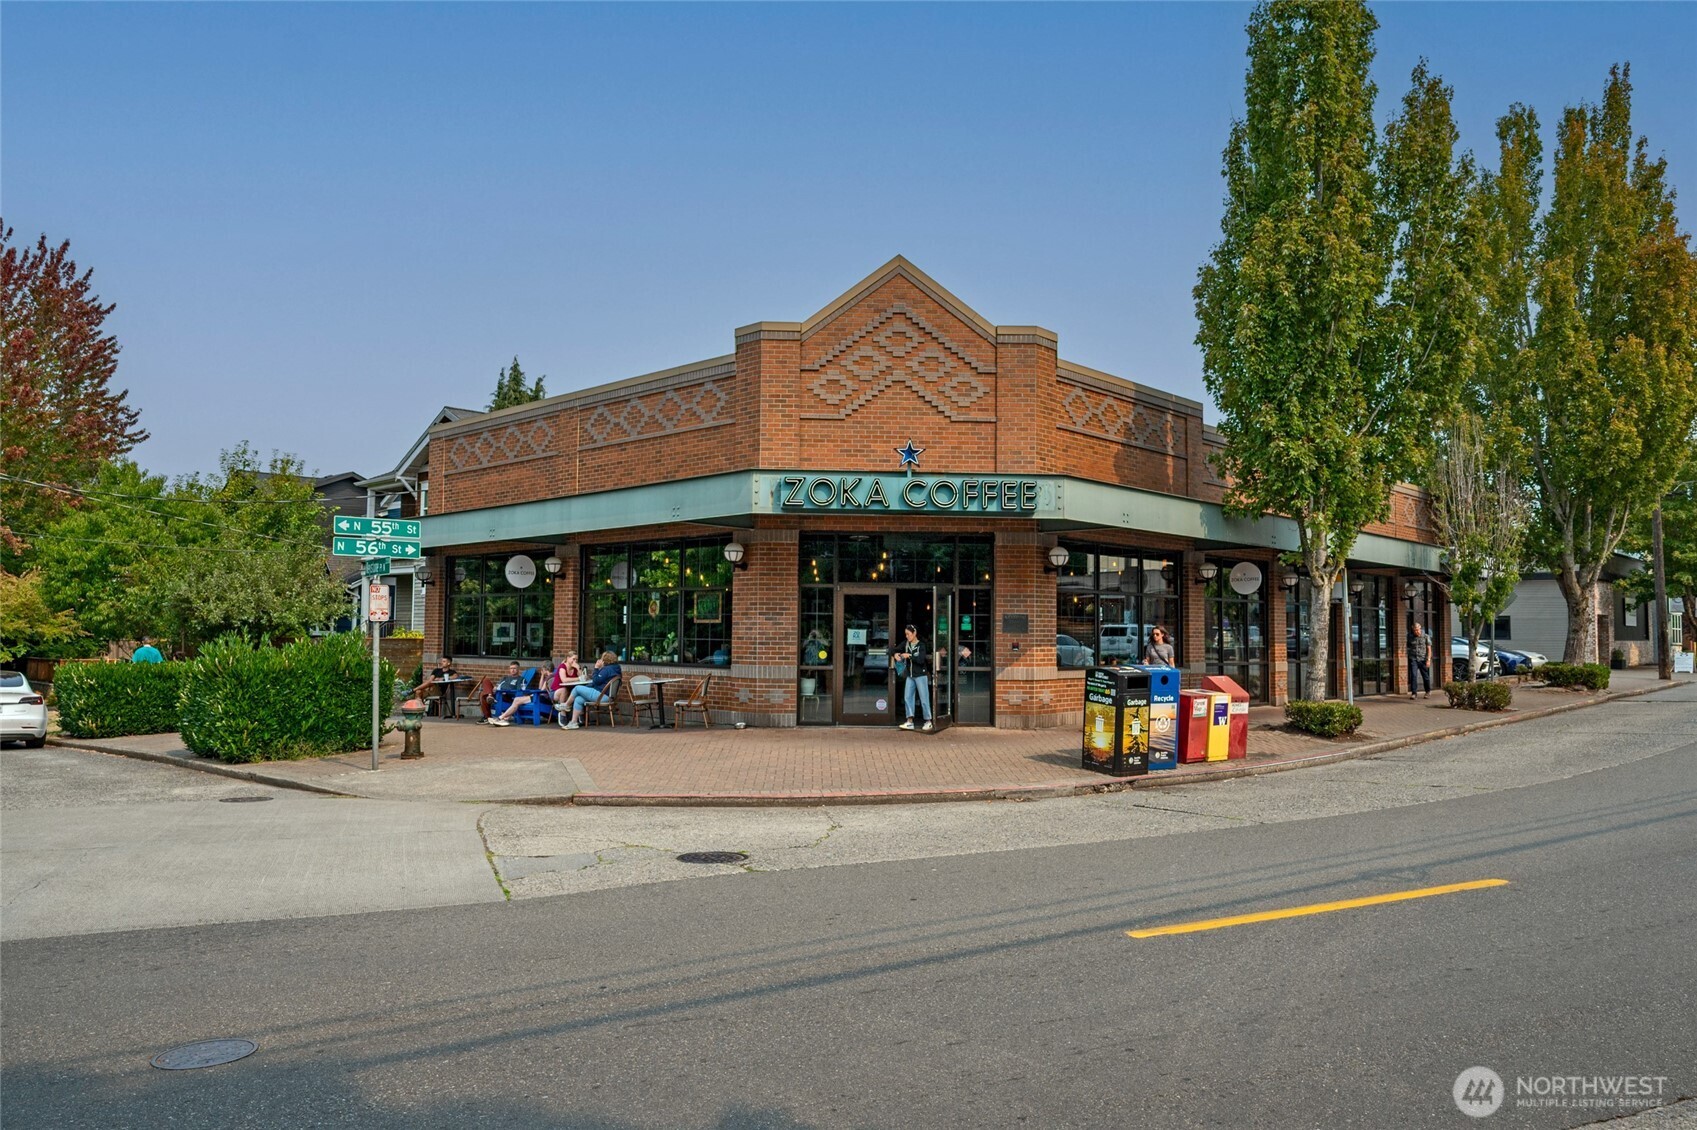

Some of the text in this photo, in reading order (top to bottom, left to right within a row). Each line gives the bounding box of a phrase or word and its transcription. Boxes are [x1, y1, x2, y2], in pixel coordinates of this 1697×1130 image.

[782, 475, 1038, 511] ZOKA COFFEE
[353, 520, 417, 535] N 55th St
[337, 540, 402, 555] N 56th St
[1088, 692, 1113, 705] Garbage
[1126, 698, 1147, 706] Garbage
[1153, 694, 1174, 703] Recycle
